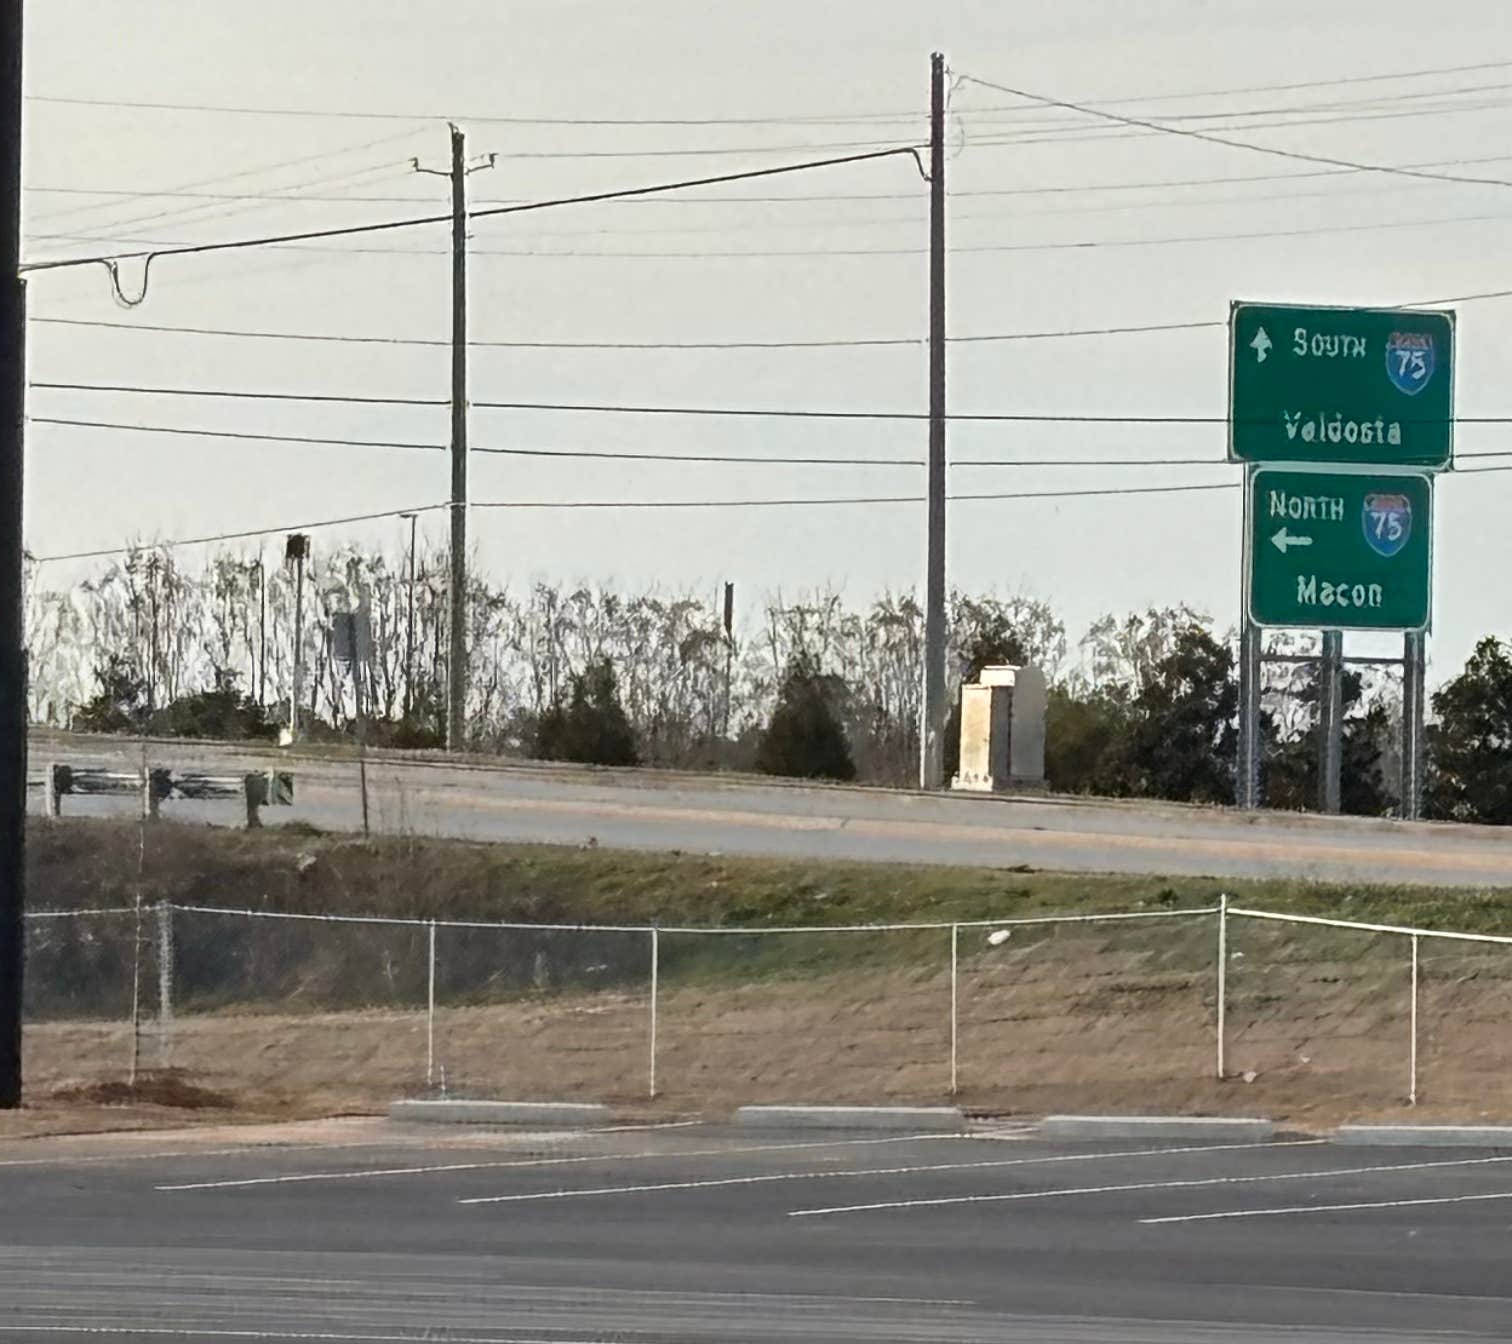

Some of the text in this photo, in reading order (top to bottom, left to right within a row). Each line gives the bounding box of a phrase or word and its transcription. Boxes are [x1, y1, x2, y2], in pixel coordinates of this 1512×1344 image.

[1395, 350, 1426, 379] 75
[1284, 410, 1401, 445] Valdosta
[1269, 490, 1344, 521] NORTH
[1370, 511, 1402, 540] 75
[1296, 574, 1383, 607] Macon
